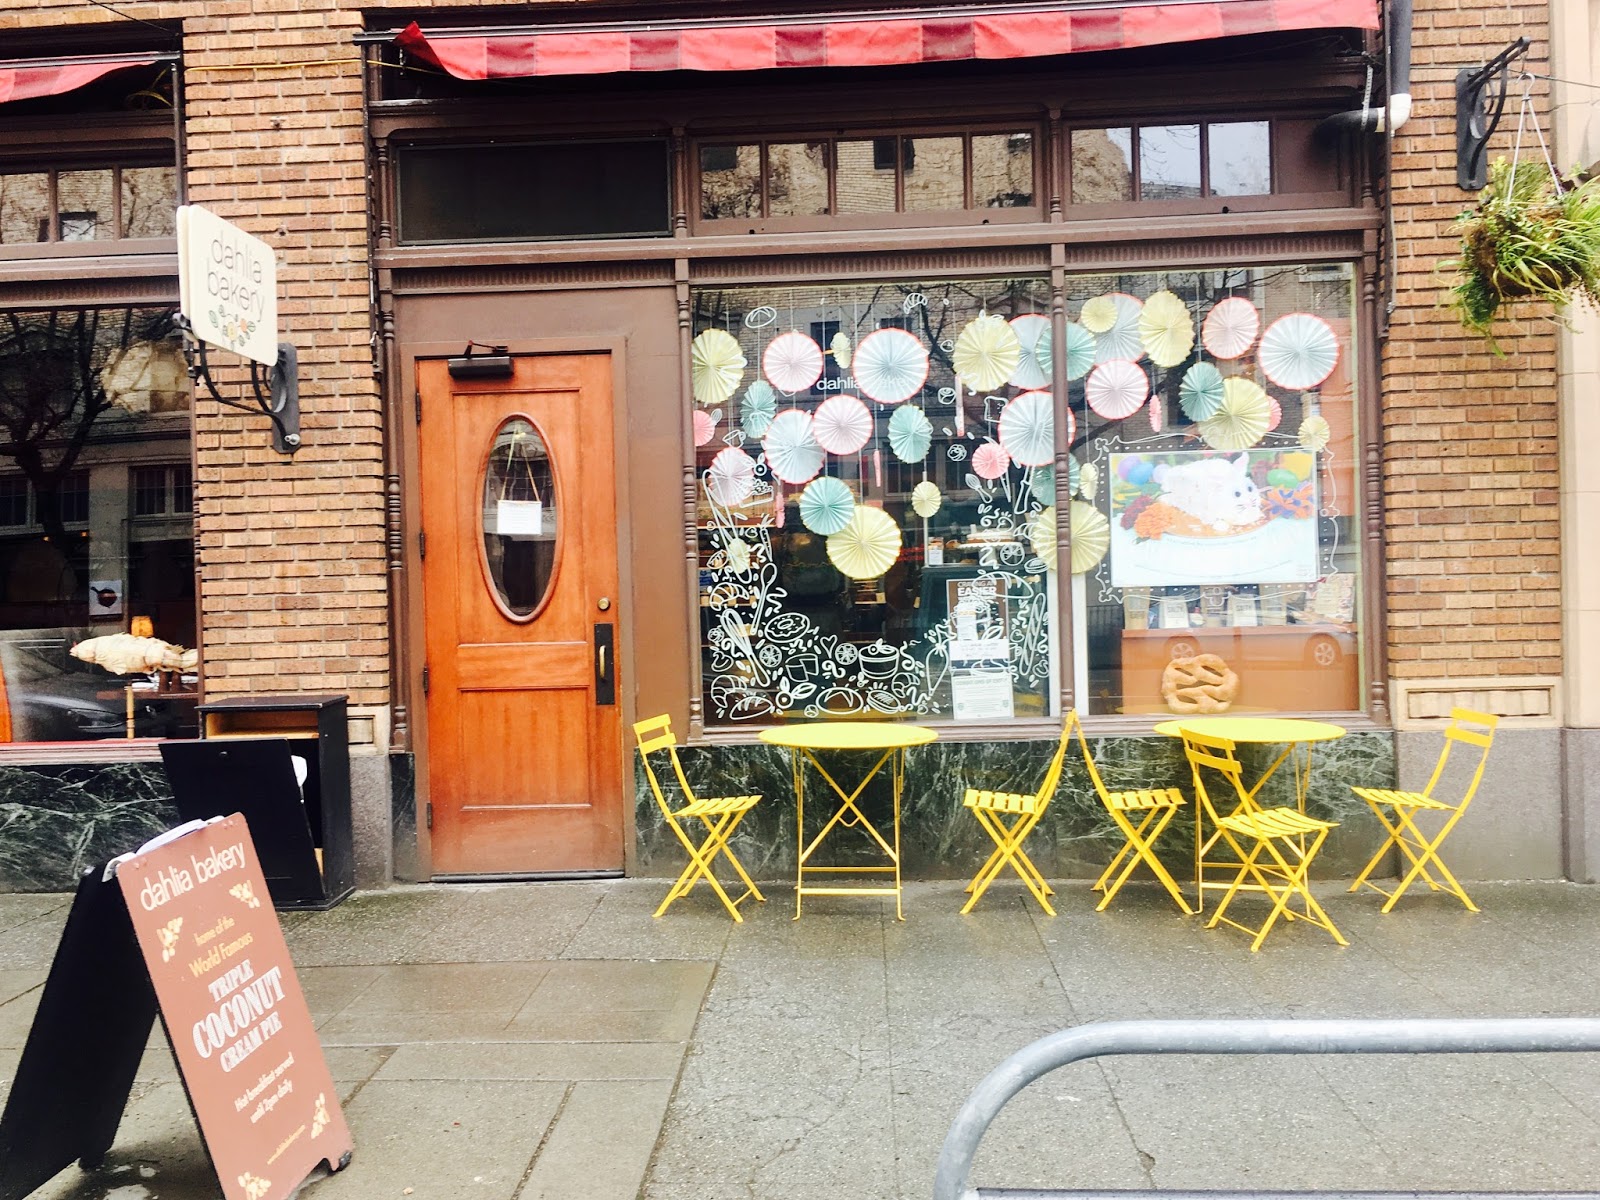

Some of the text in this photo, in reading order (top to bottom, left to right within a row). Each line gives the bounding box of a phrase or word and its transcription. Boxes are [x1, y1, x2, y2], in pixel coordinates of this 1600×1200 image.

[211, 230, 262, 284] dahlia
[207, 257, 265, 323] bakery
[140, 842, 246, 911] dahlia bakery
[188, 932, 254, 978] World Famous
[193, 916, 236, 946] home of the
[208, 959, 255, 1003] TRIPLE
[192, 966, 286, 1059] COCONUT
[220, 1011, 283, 1073] CREAM PIE
